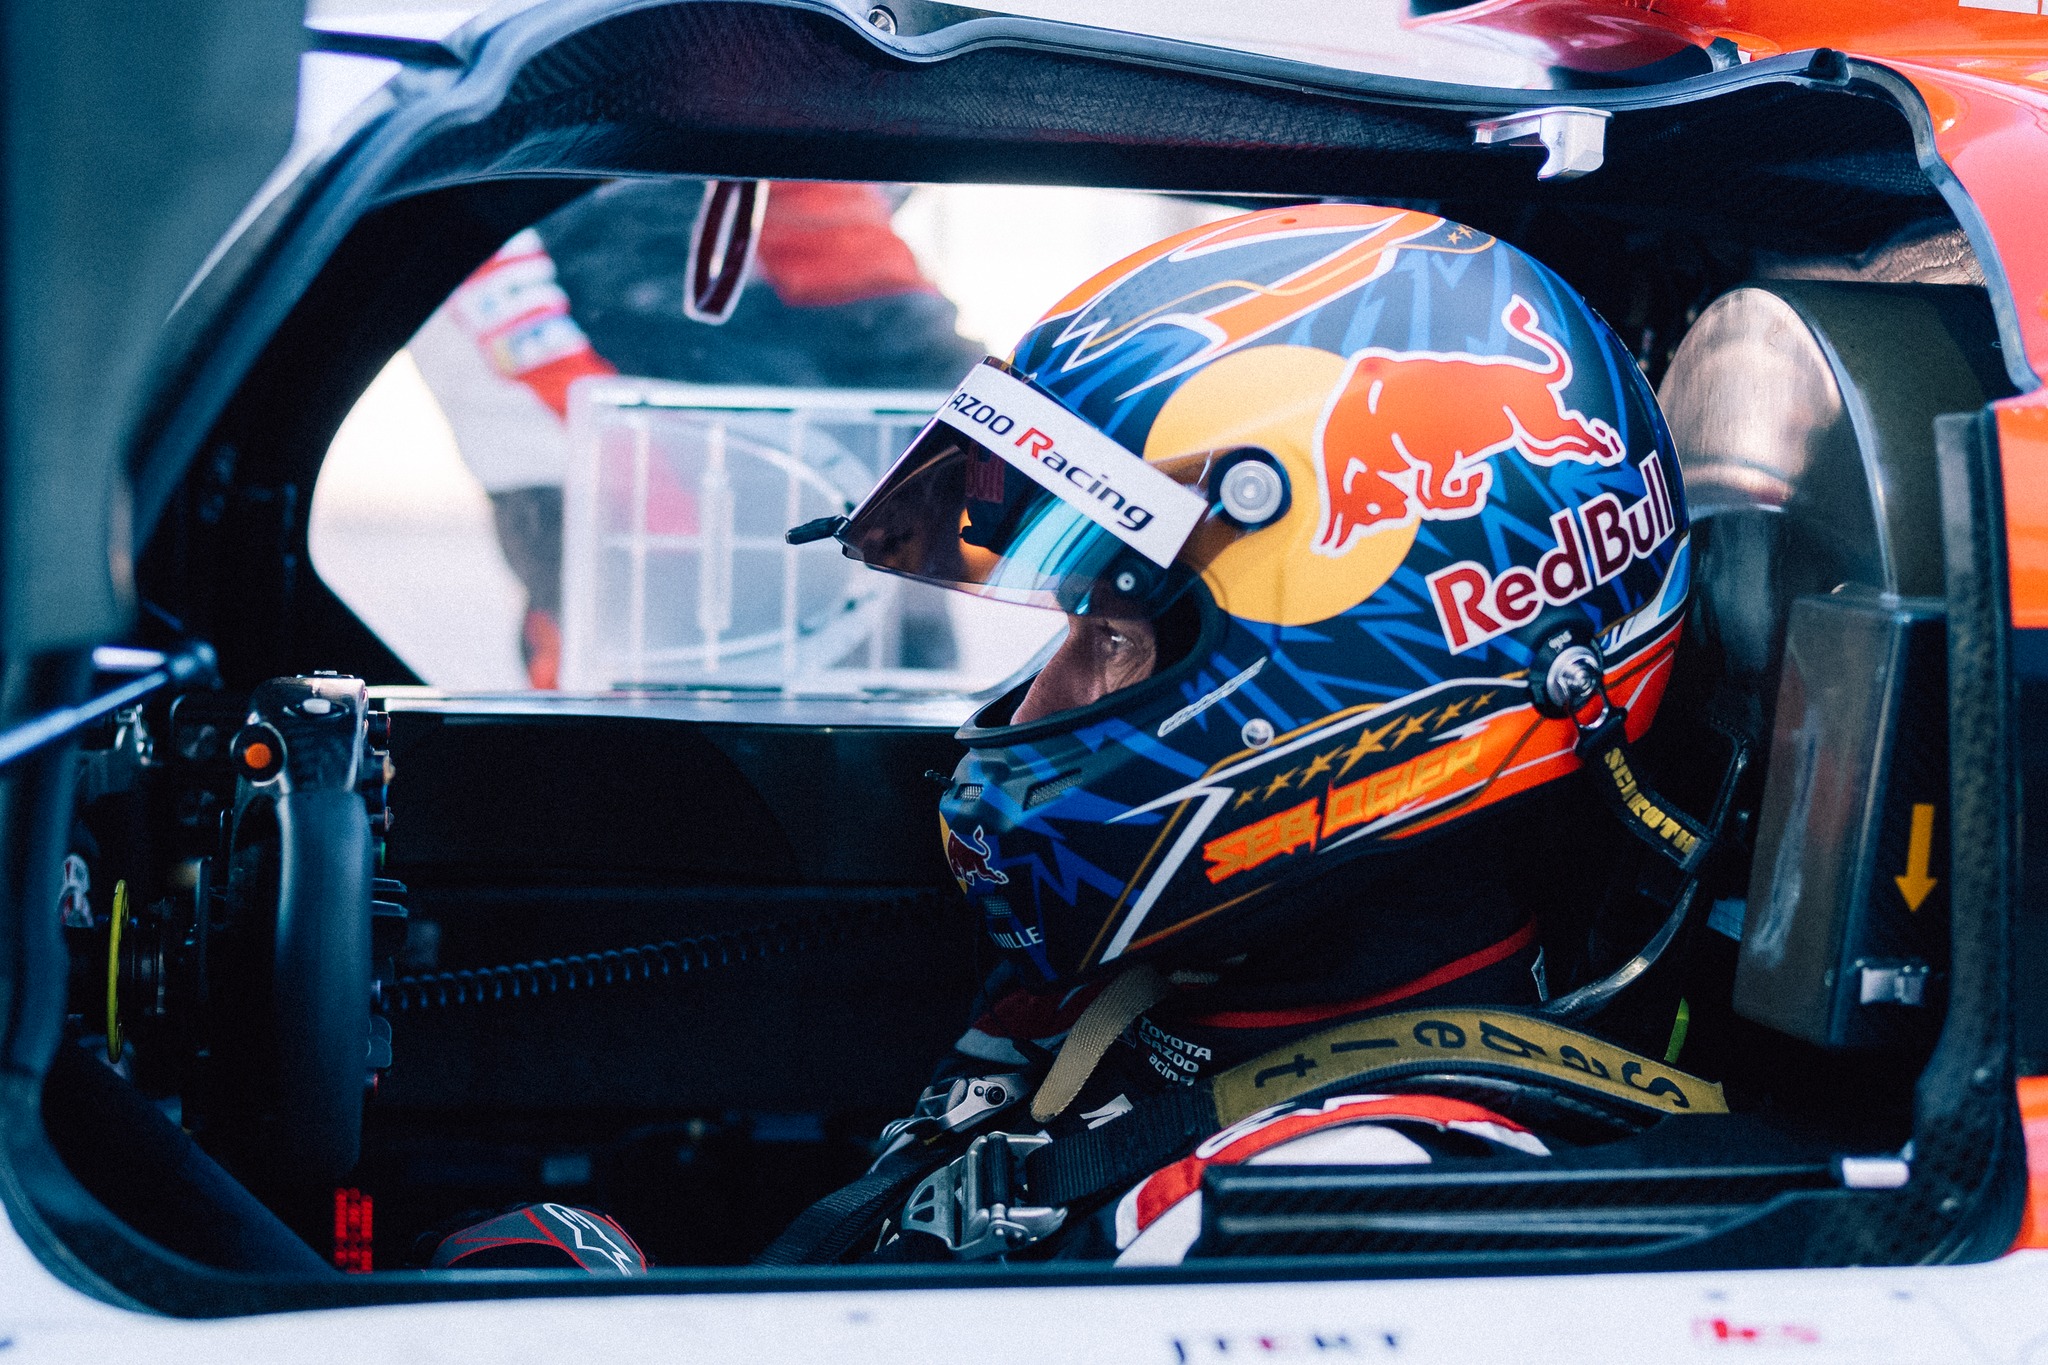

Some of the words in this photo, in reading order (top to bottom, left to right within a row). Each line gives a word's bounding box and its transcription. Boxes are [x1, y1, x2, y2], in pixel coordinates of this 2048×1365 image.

[948, 389, 1014, 435] AZOO
[1014, 426, 1155, 532] Racing
[1430, 511, 1592, 650] Red
[1580, 453, 1674, 582] Bull
[1204, 799, 1320, 882] SEB
[1323, 735, 1482, 836] OGIER
[1139, 1030, 1200, 1073] GAZOO
[1141, 1016, 1212, 1061] TOYOTA
[1146, 1050, 1195, 1087] acing
[1254, 1019, 1690, 1108] Sabelt
